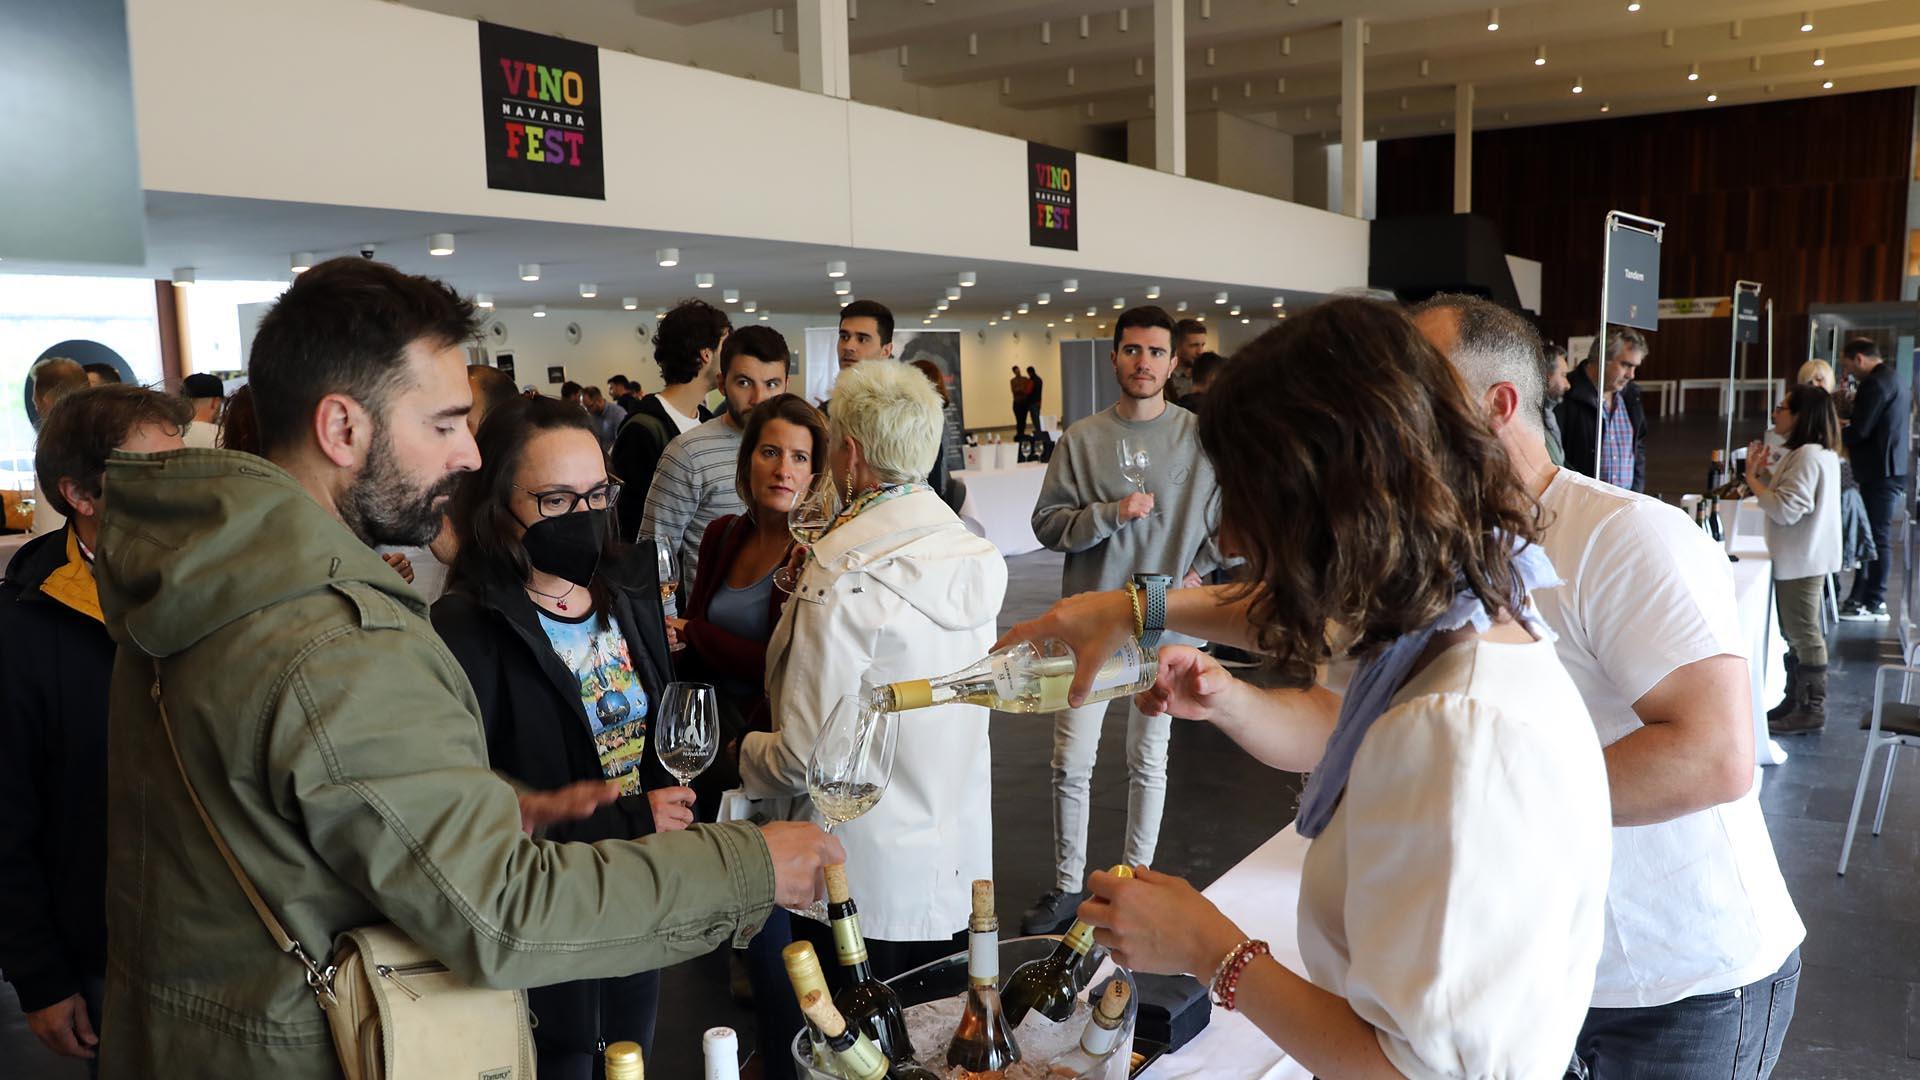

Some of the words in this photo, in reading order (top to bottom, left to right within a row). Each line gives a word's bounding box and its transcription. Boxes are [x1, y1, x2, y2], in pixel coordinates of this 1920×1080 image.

[500, 58, 584, 106] VINO
[502, 104, 584, 126] NAVARRA
[505, 123, 584, 166] FEST
[1036, 163, 1070, 191] VINO
[1037, 204, 1070, 230] FEST
